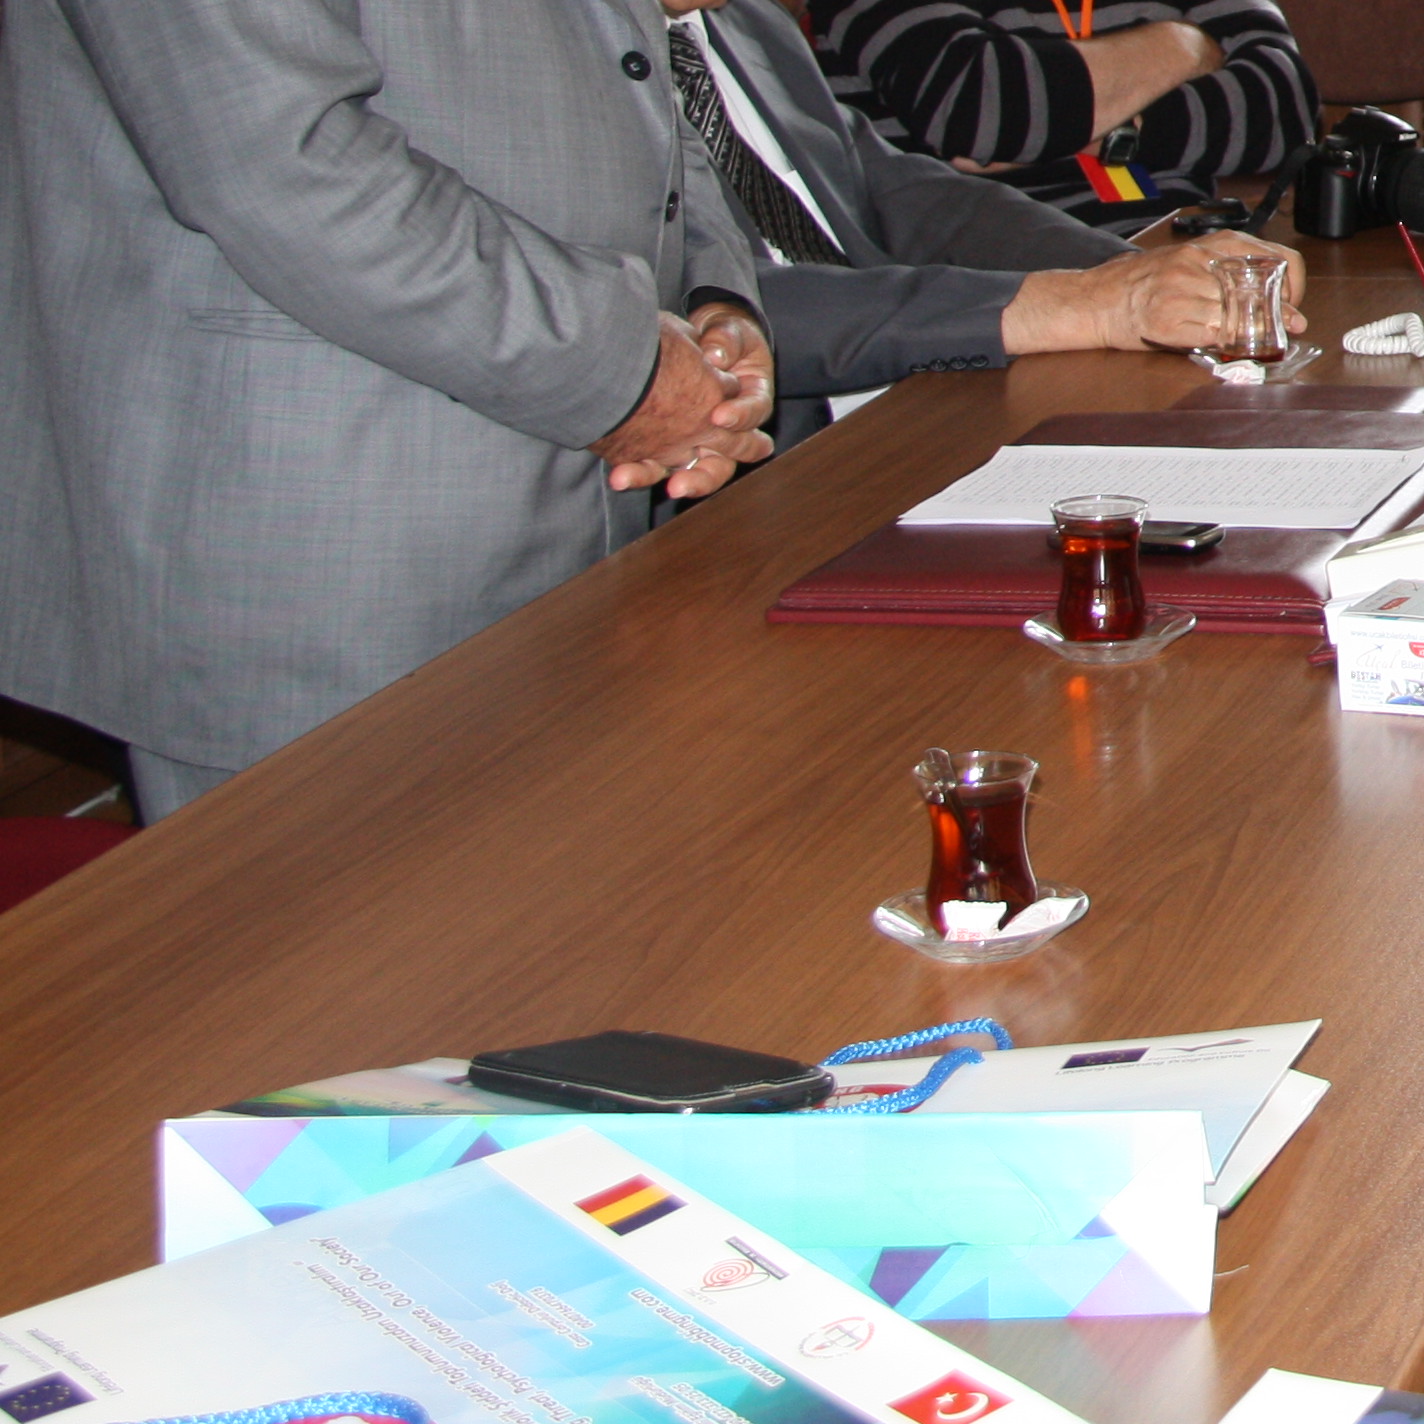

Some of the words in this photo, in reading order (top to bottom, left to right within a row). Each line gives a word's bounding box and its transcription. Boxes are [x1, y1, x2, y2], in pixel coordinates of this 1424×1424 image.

[351, 1263, 381, 1282] Our
[367, 1279, 394, 1291] of
[381, 1289, 415, 1308] Out
[373, 1318, 472, 1384] Toplumumuzdan
[450, 1340, 537, 1394] Psychological
